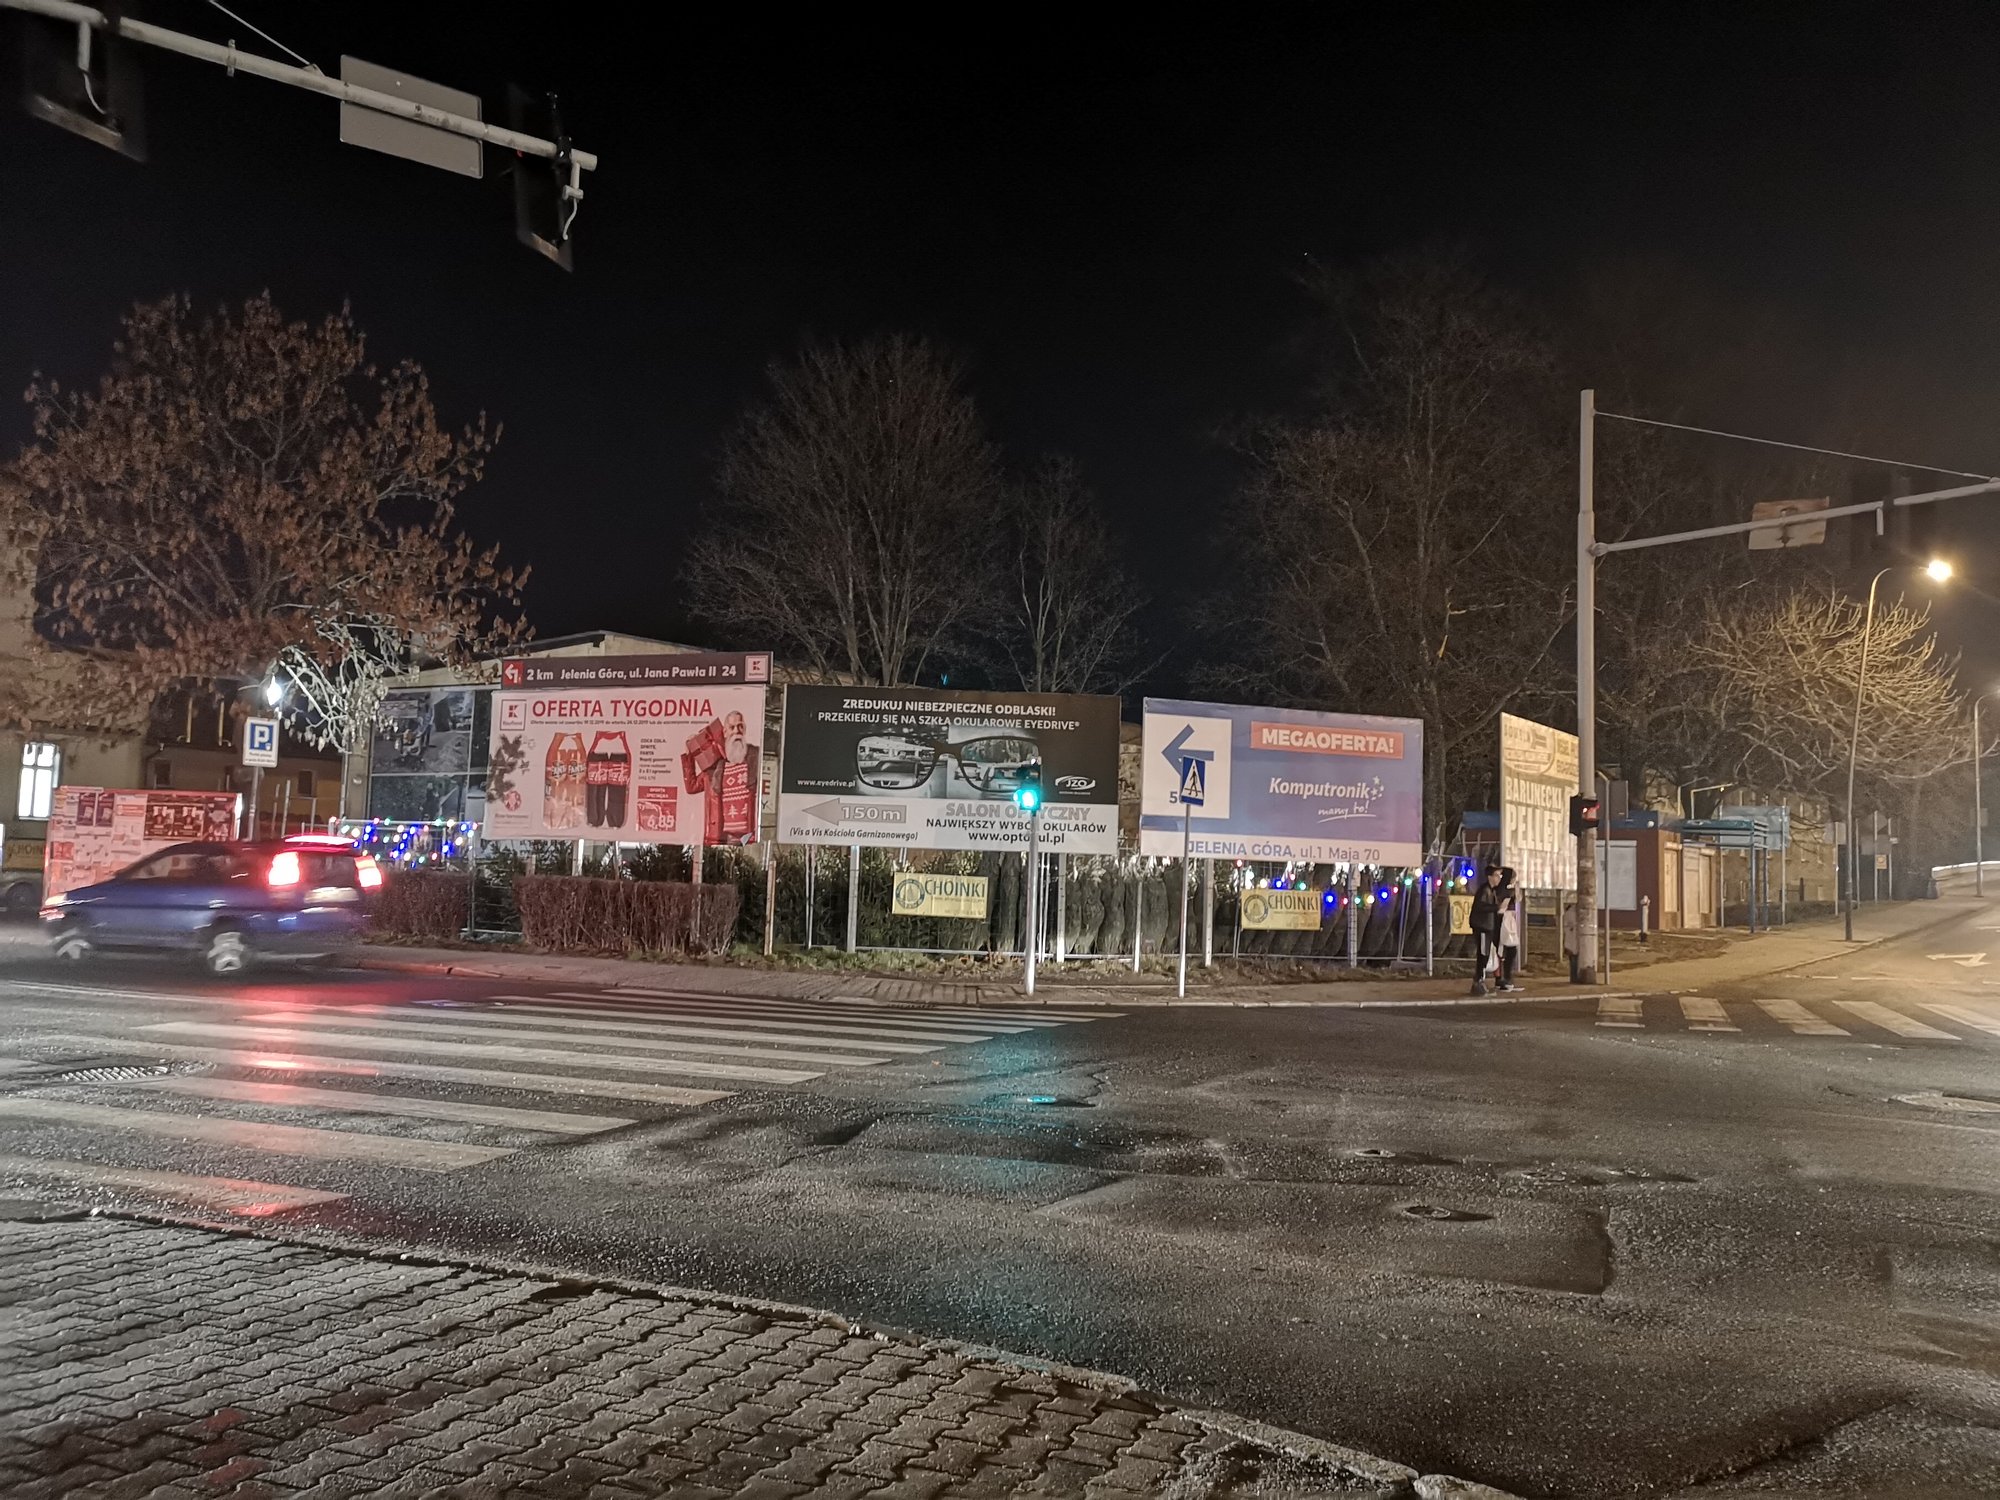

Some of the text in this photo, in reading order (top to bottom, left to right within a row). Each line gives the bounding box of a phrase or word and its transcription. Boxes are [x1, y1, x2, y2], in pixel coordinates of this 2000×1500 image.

[526, 665, 736, 681] 2 km Jelenia Góra, ul. Jana Pawła II 24
[532, 699, 713, 717] OFERTA TYGODNIA
[842, 699, 1057, 718] ZREDUKUJ NIEBEZPIECZNE ODBLASKI!
[818, 711, 880, 724] PRZEKIERUJ
[881, 714, 898, 726] SIĘ
[901, 715, 917, 725] NA
[918, 715, 951, 727] SZKŁA
[953, 716, 1022, 729] OKULAROWE
[254, 725, 270, 748] P
[1261, 728, 1395, 754] MEGAOFERTA!
[797, 779, 856, 788] www.eyedrive.pl
[1065, 779, 1088, 788] JZO
[1270, 777, 1371, 799] Komputronik
[841, 806, 901, 821] 150 m
[945, 803, 1001, 818] SALON
[1318, 800, 1370, 819] mamy to!
[812, 827, 823, 837] Vis
[824, 828, 855, 838] Kościoła
[926, 818, 996, 831] NAJWIĘKSZY
[1043, 821, 1107, 833] OKULARÓW
[1505, 803, 1561, 852] PELLET
[1188, 841, 1247, 856] JELENIA
[1251, 841, 1297, 858] GÓRA,
[1329, 847, 1359, 862] Maja
[1364, 848, 1380, 861] 70
[924, 879, 986, 898] CHOINKI
[1267, 894, 1319, 911] CHOINKI
